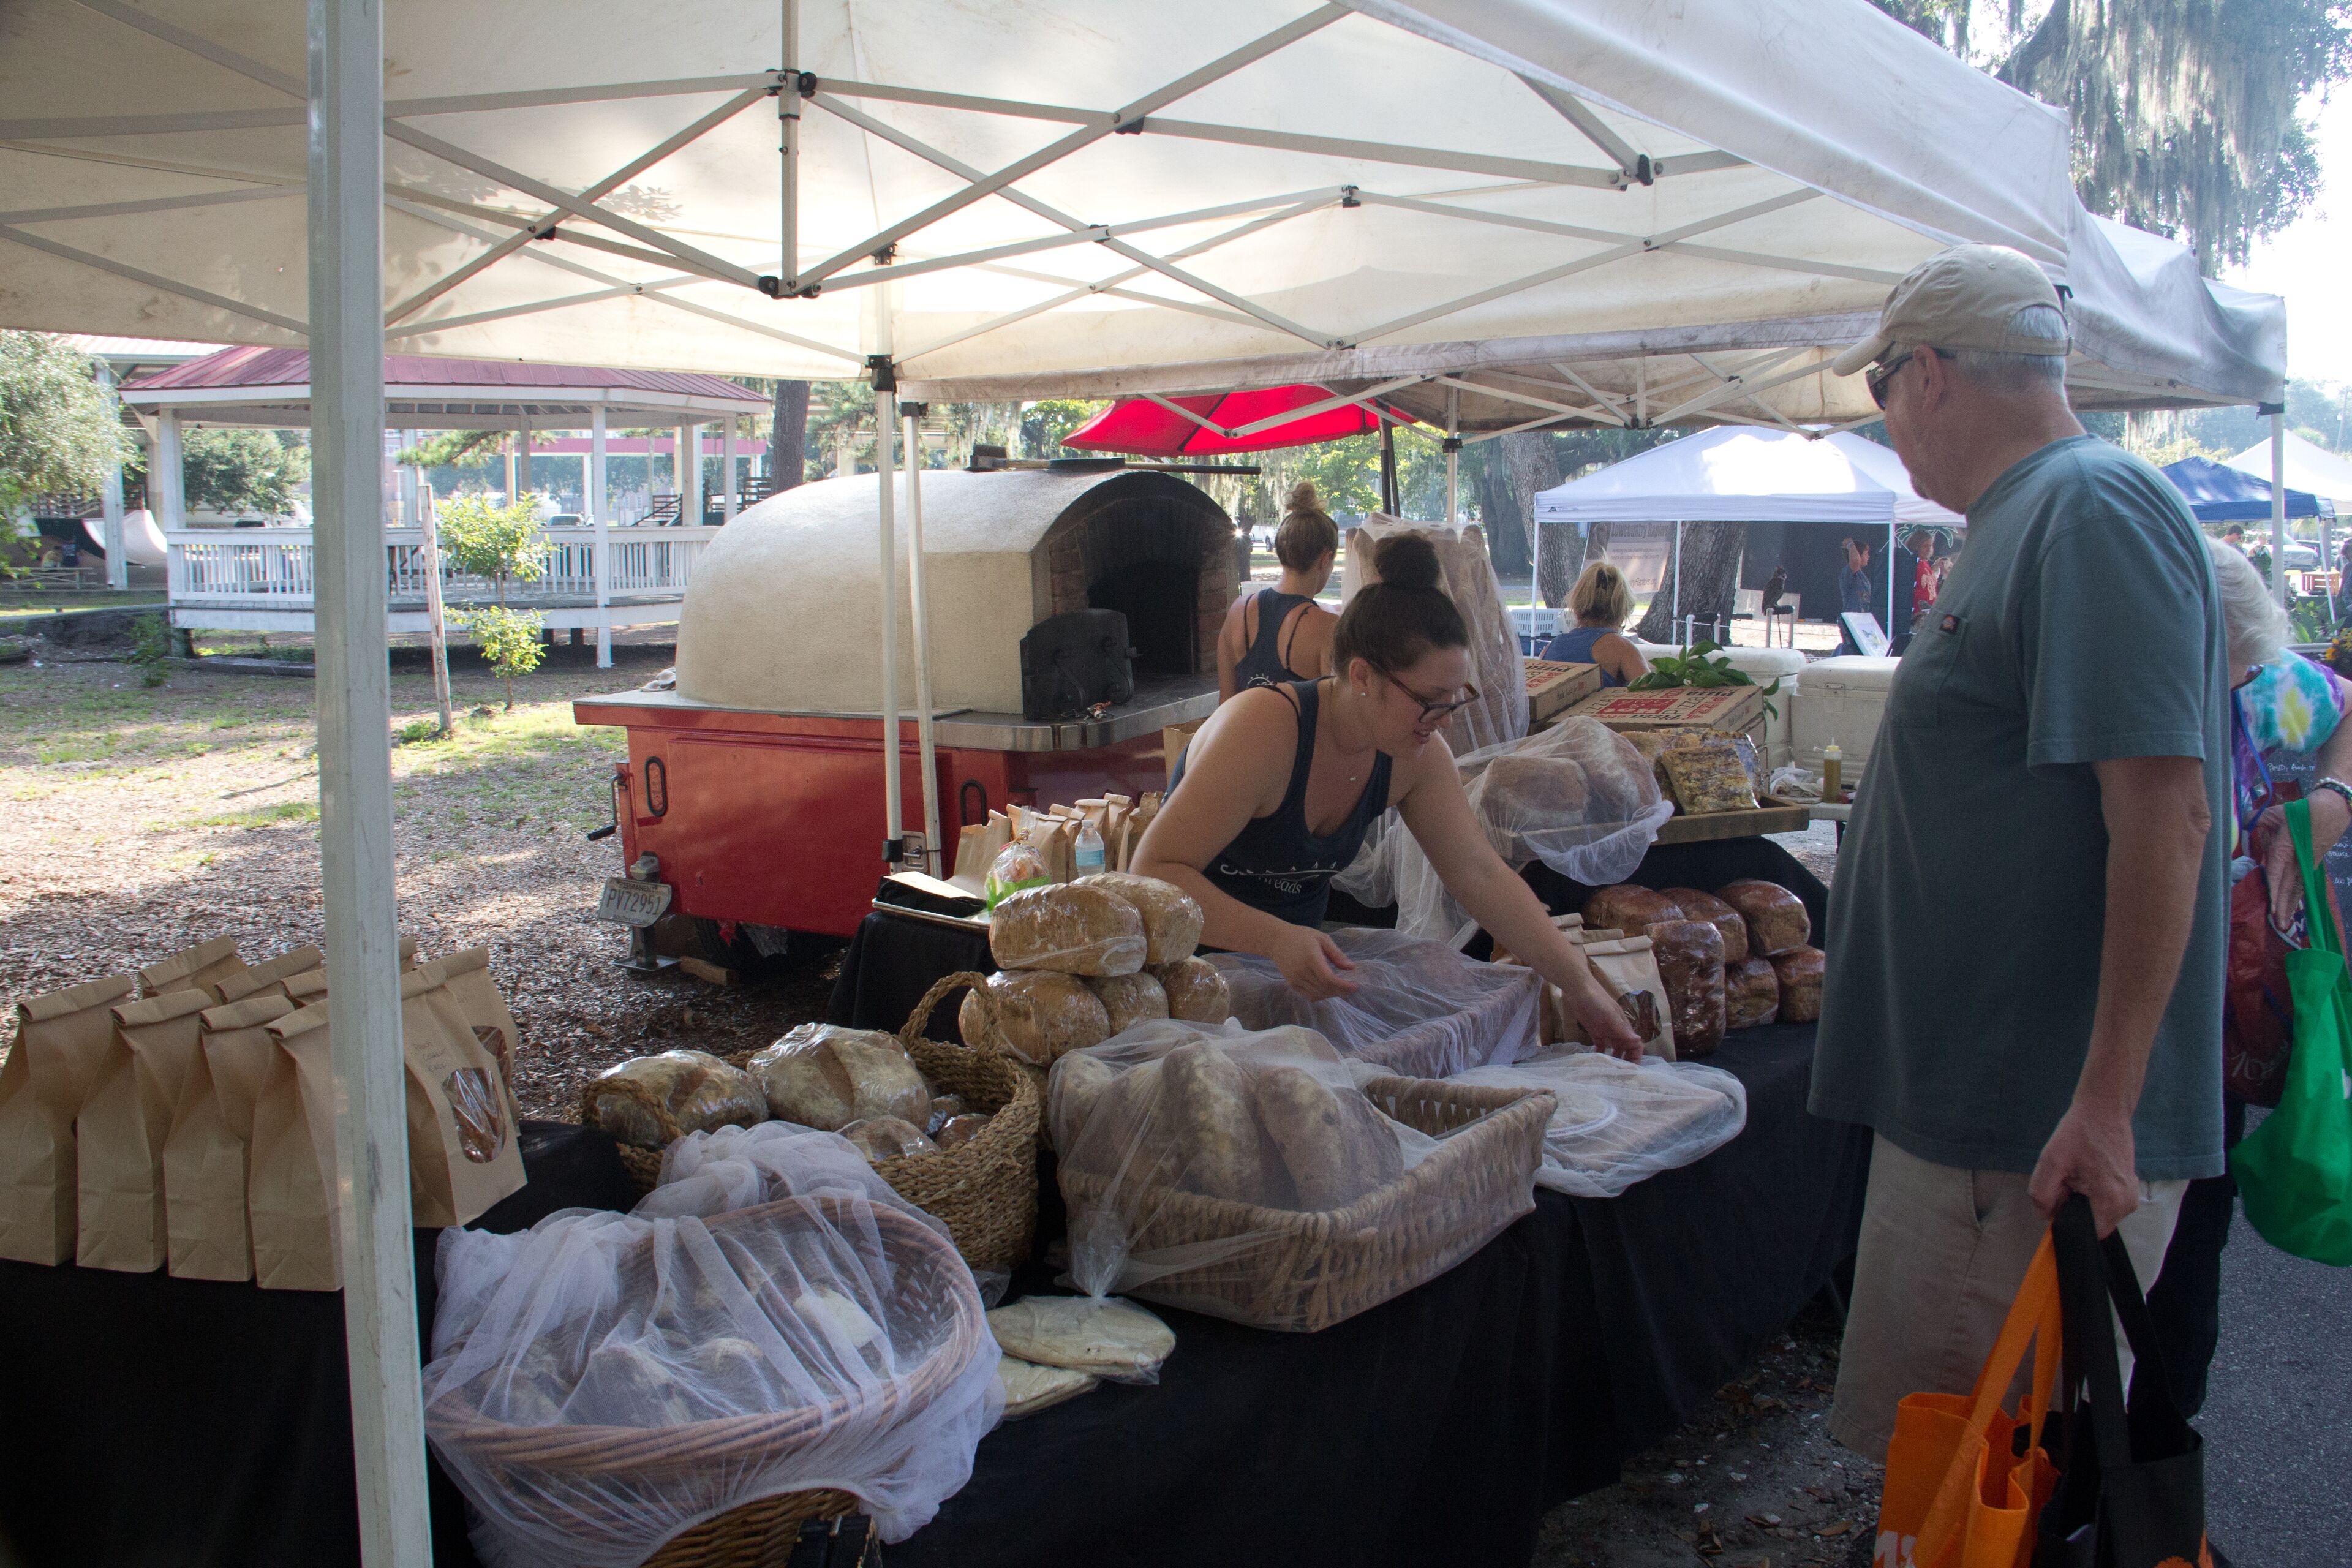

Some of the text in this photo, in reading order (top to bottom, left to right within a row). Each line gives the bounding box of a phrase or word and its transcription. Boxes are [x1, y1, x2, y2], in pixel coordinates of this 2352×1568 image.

[1611, 522, 1646, 538] Lowcountry
[619, 882, 657, 892] PERMANENT
[606, 888, 662, 916] PV72951
